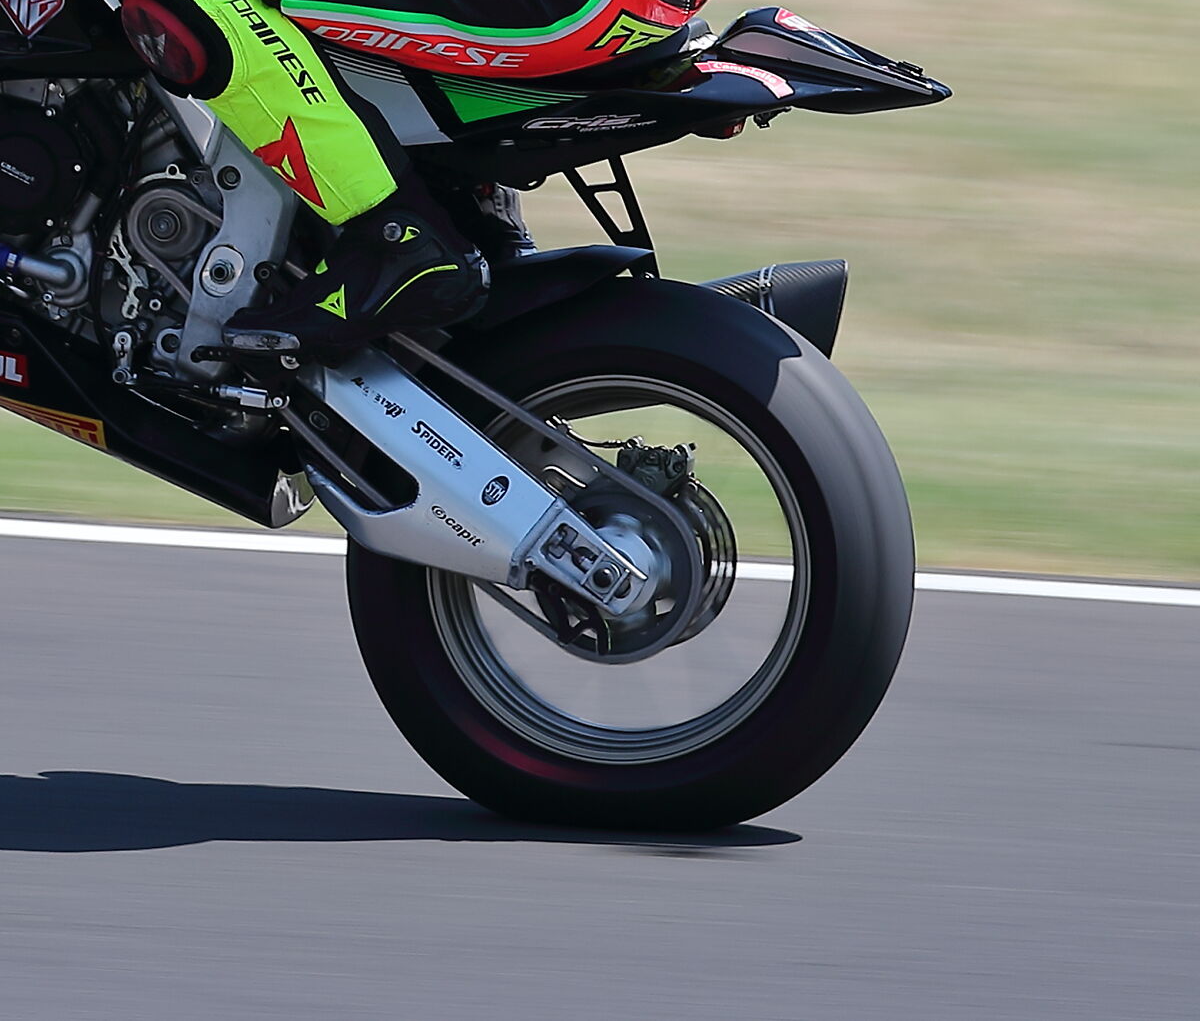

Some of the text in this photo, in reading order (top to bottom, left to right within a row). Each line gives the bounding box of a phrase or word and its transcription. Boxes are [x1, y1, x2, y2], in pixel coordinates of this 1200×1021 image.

[313, 25, 531, 68] DAINESE
[410, 420, 463, 462] SPIDER
[444, 517, 482, 547] capit
